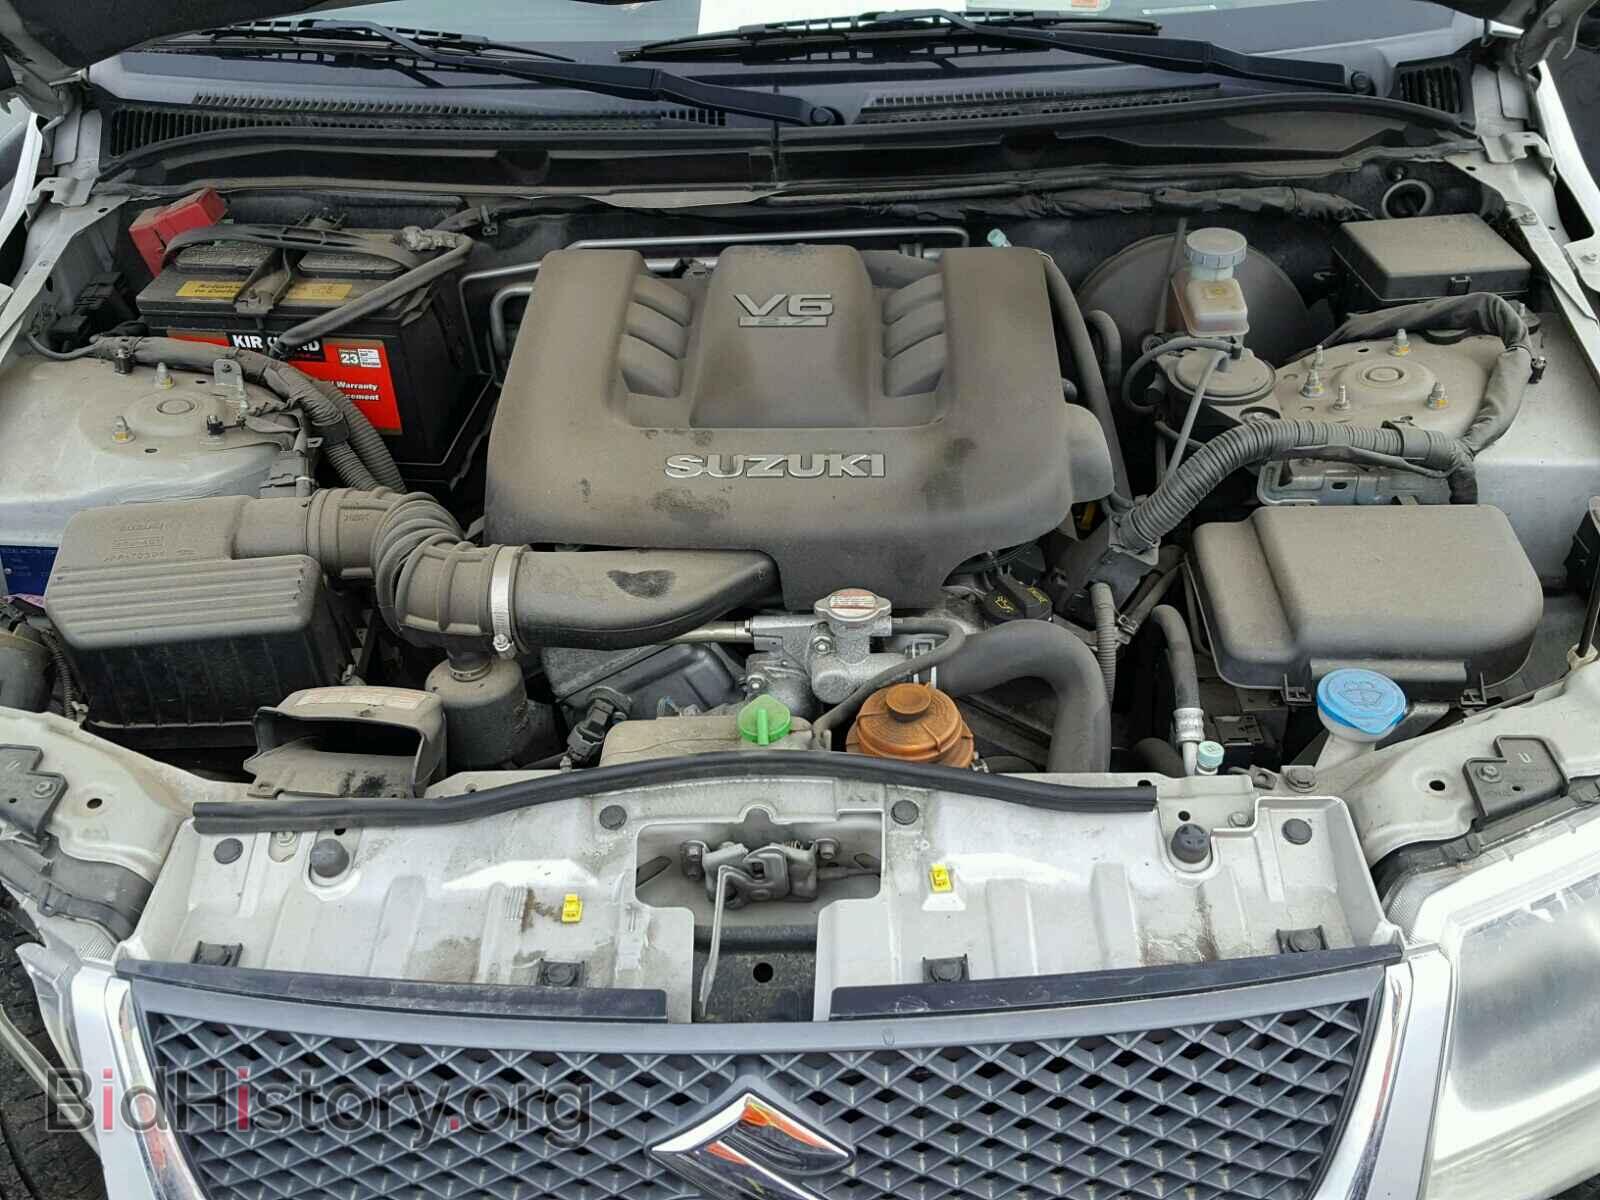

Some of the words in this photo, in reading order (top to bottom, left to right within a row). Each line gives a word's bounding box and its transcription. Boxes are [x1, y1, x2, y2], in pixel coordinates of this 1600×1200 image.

[733, 293, 833, 316] V6
[340, 352, 359, 364] 23
[337, 380, 378, 391] Warranty
[344, 393, 379, 401] cement
[664, 453, 886, 478] SUZUKI
